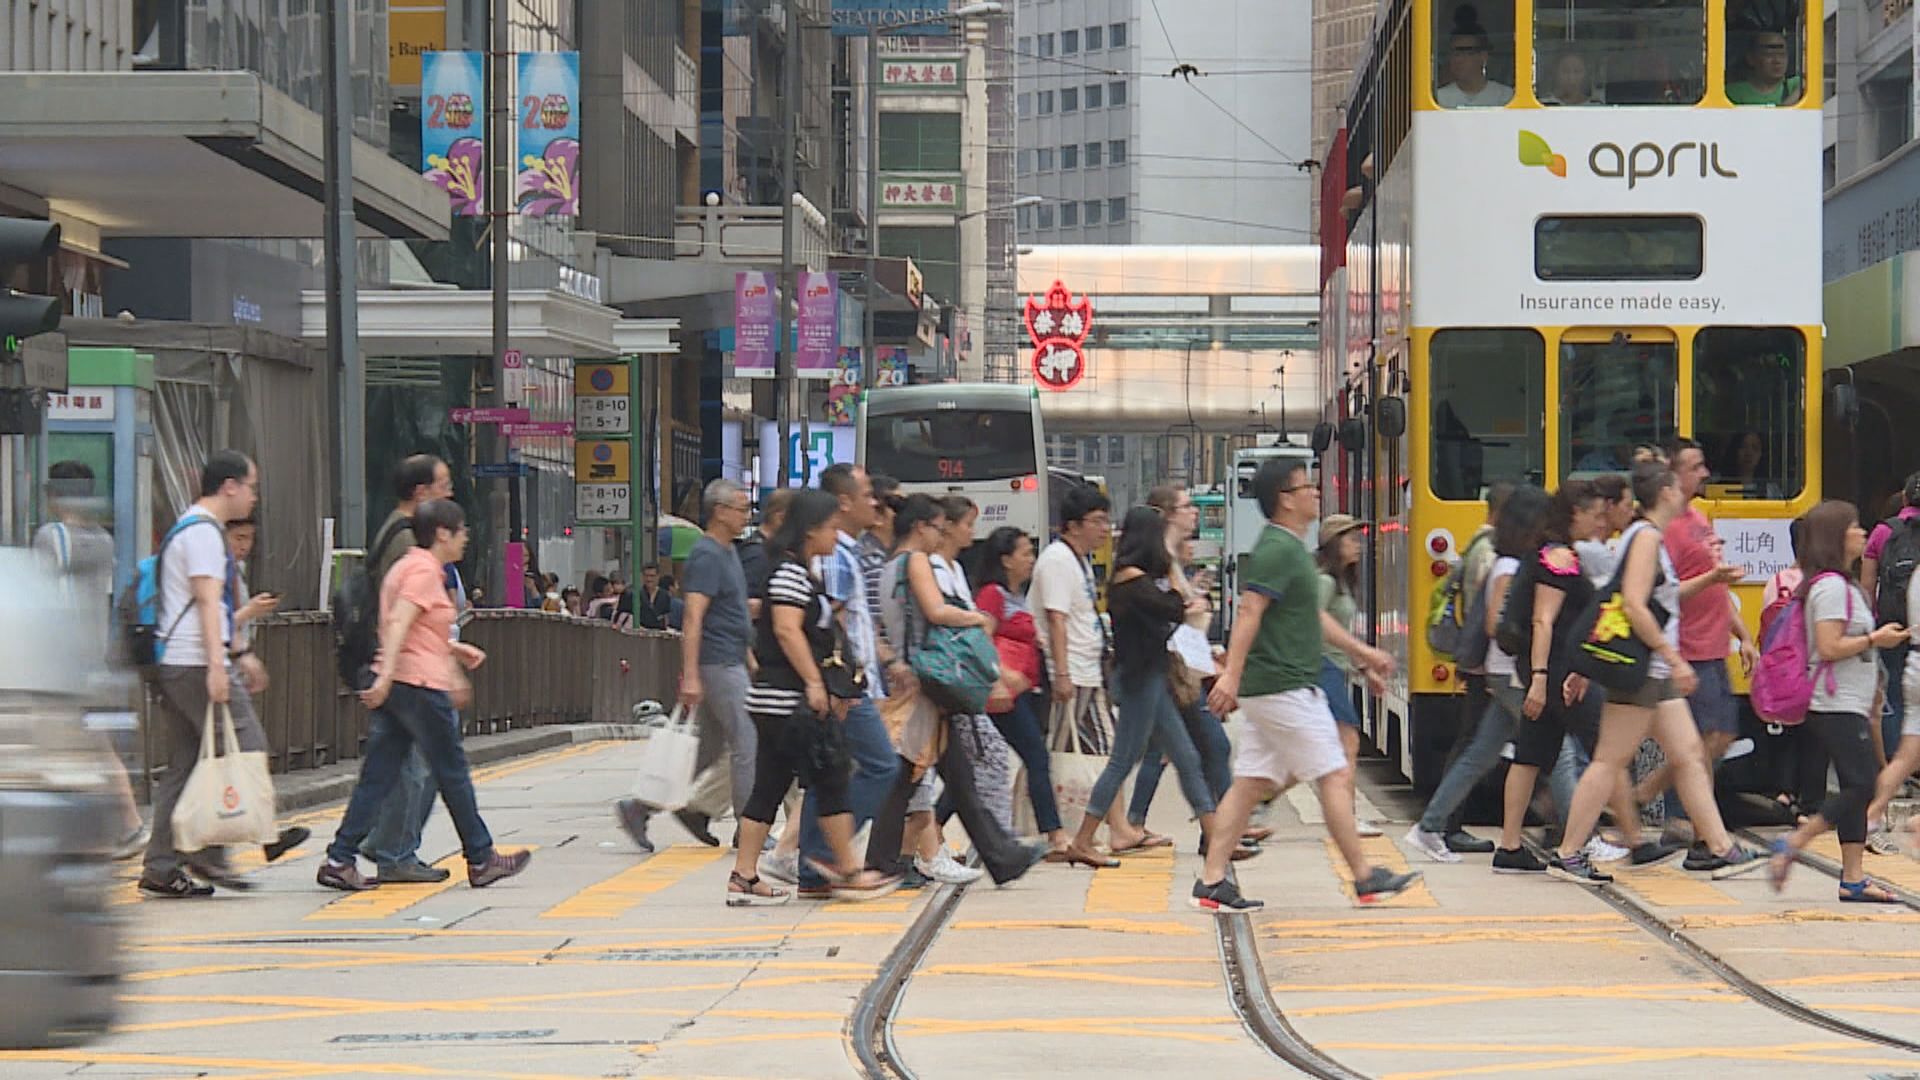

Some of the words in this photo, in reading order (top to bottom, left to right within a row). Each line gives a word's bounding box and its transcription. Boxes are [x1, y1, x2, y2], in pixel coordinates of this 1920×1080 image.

[831, 8, 947, 26] STATIONERS
[1588, 141, 1738, 190] april
[1520, 293, 1614, 310] Insurance
[1620, 293, 1672, 310] made
[1679, 296, 1726, 313] easy.
[595, 399, 626, 412] 8-10
[596, 416, 621, 427] 5-7
[938, 458, 965, 480] 914
[596, 487, 627, 499] 8-10
[596, 503, 619, 515] 4-7
[1734, 531, 1775, 554] 北角
